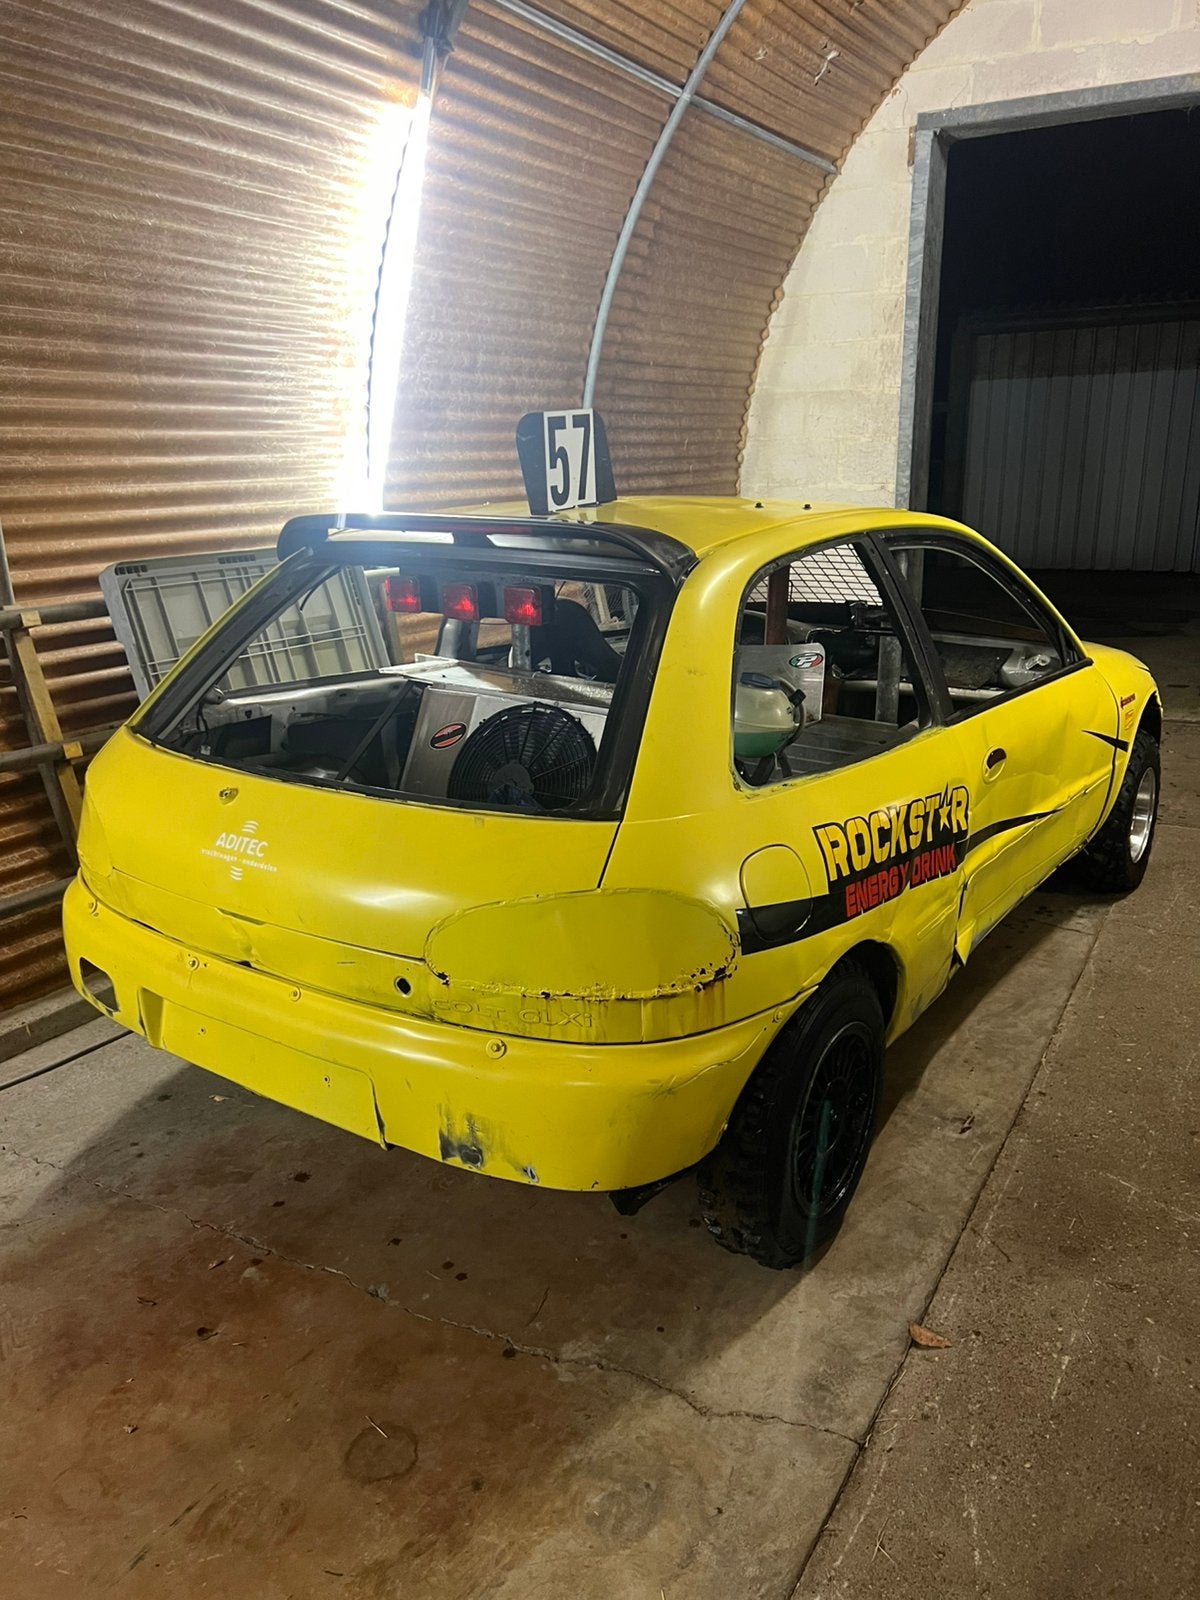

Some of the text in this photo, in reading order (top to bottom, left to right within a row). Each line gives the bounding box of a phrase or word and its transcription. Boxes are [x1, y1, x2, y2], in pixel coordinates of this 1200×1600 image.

[548, 413, 590, 506] 57
[216, 832, 268, 858] ADITEC
[813, 784, 968, 882] ROCKSTAR
[845, 843, 956, 918] ENERGY DRINK
[431, 999, 505, 1019] COLT
